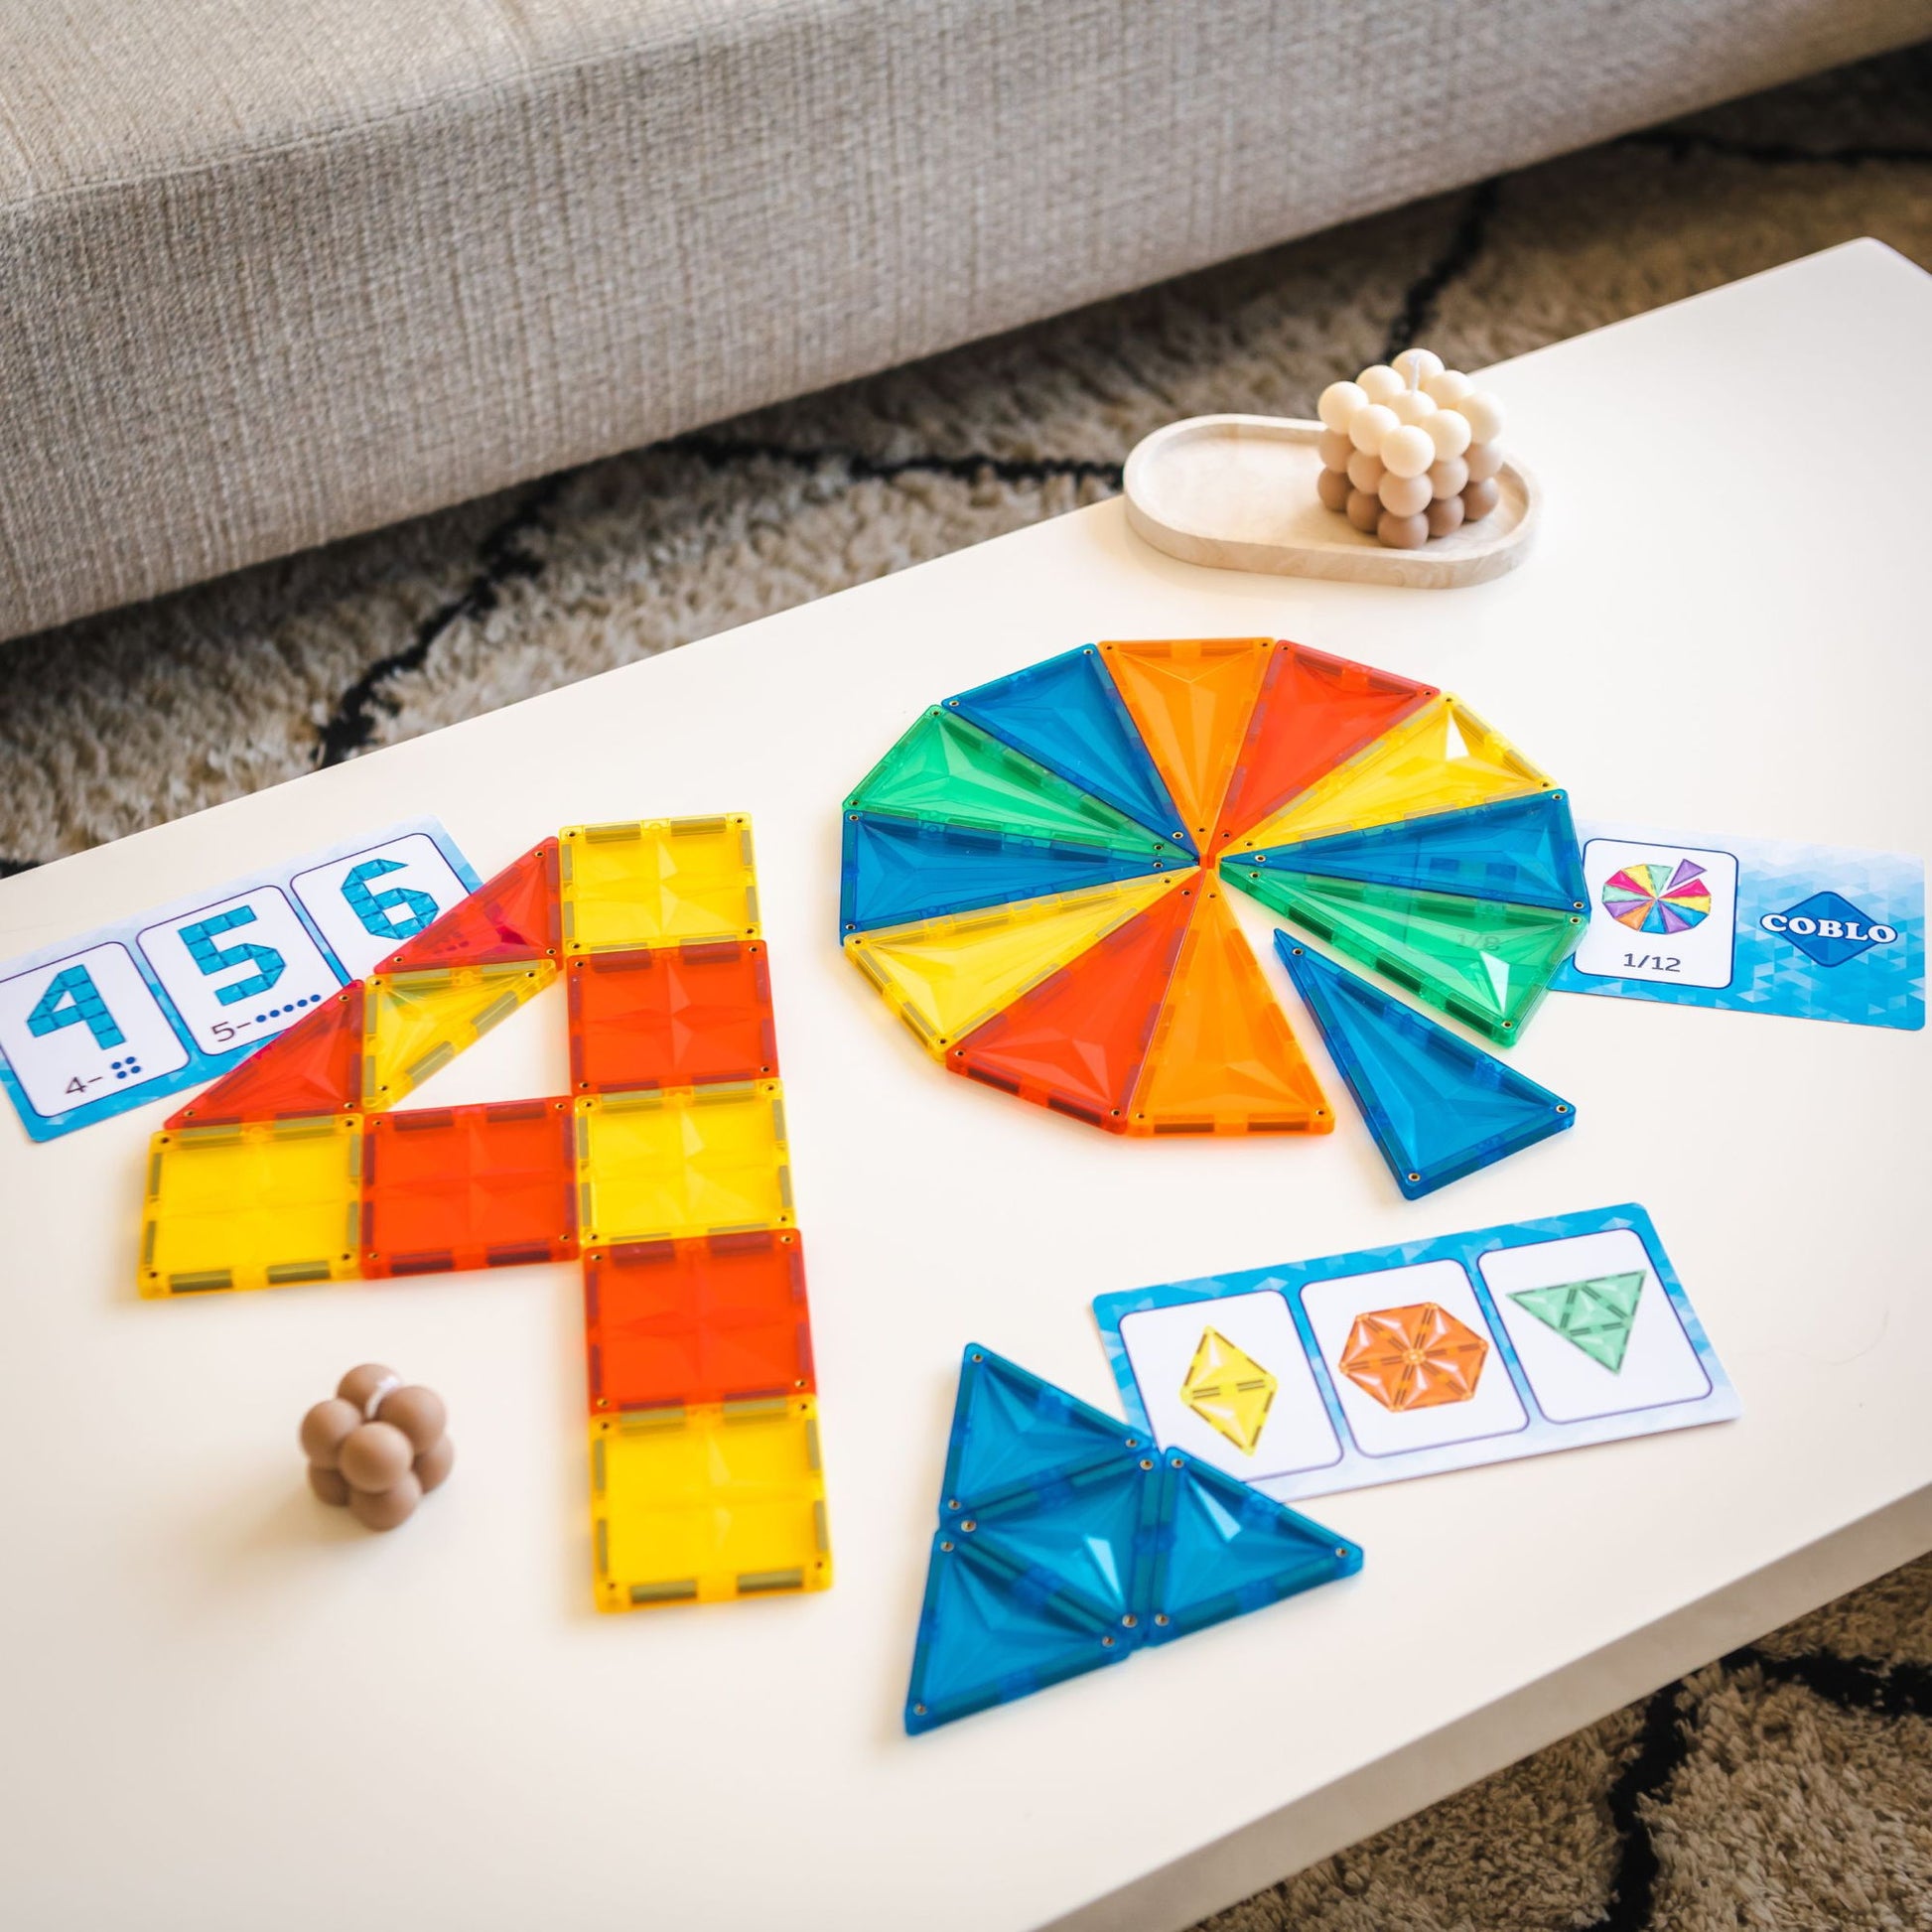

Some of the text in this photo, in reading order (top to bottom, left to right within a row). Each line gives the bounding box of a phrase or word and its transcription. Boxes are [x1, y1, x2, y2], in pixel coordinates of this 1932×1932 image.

[340, 858, 441, 940] 6
[1760, 912, 1898, 944] COBLO
[177, 904, 287, 1007] 5
[1623, 952, 1682, 974] 1/12
[26, 963, 126, 1051] 4
